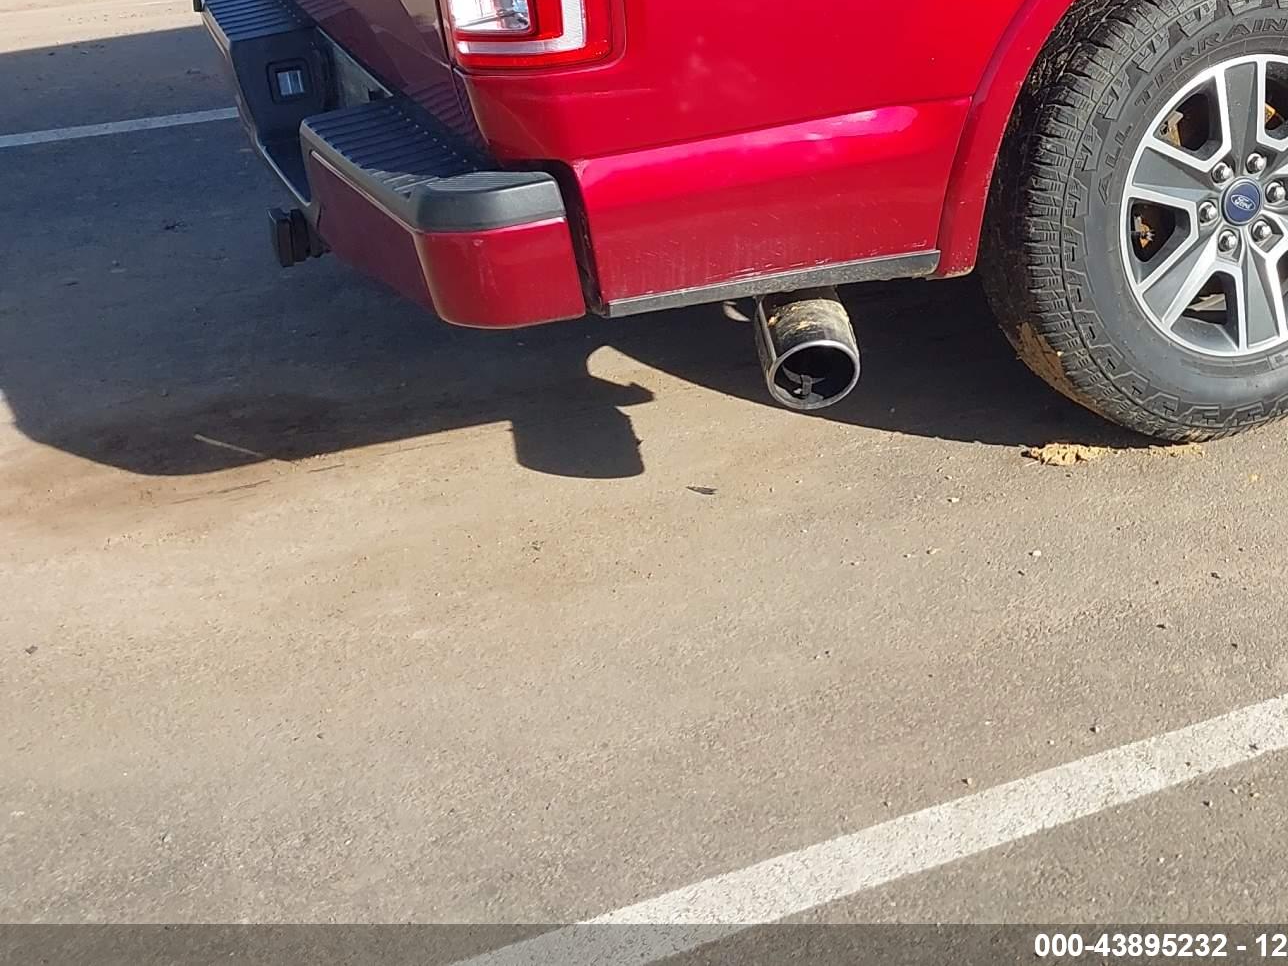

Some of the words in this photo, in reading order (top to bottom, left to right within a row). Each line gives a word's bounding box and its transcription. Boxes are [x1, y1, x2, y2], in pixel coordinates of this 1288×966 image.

[1098, 120, 1134, 205] ALL
[1134, 17, 1288, 107] TERRAIN
[1232, 195, 1254, 210] Ford
